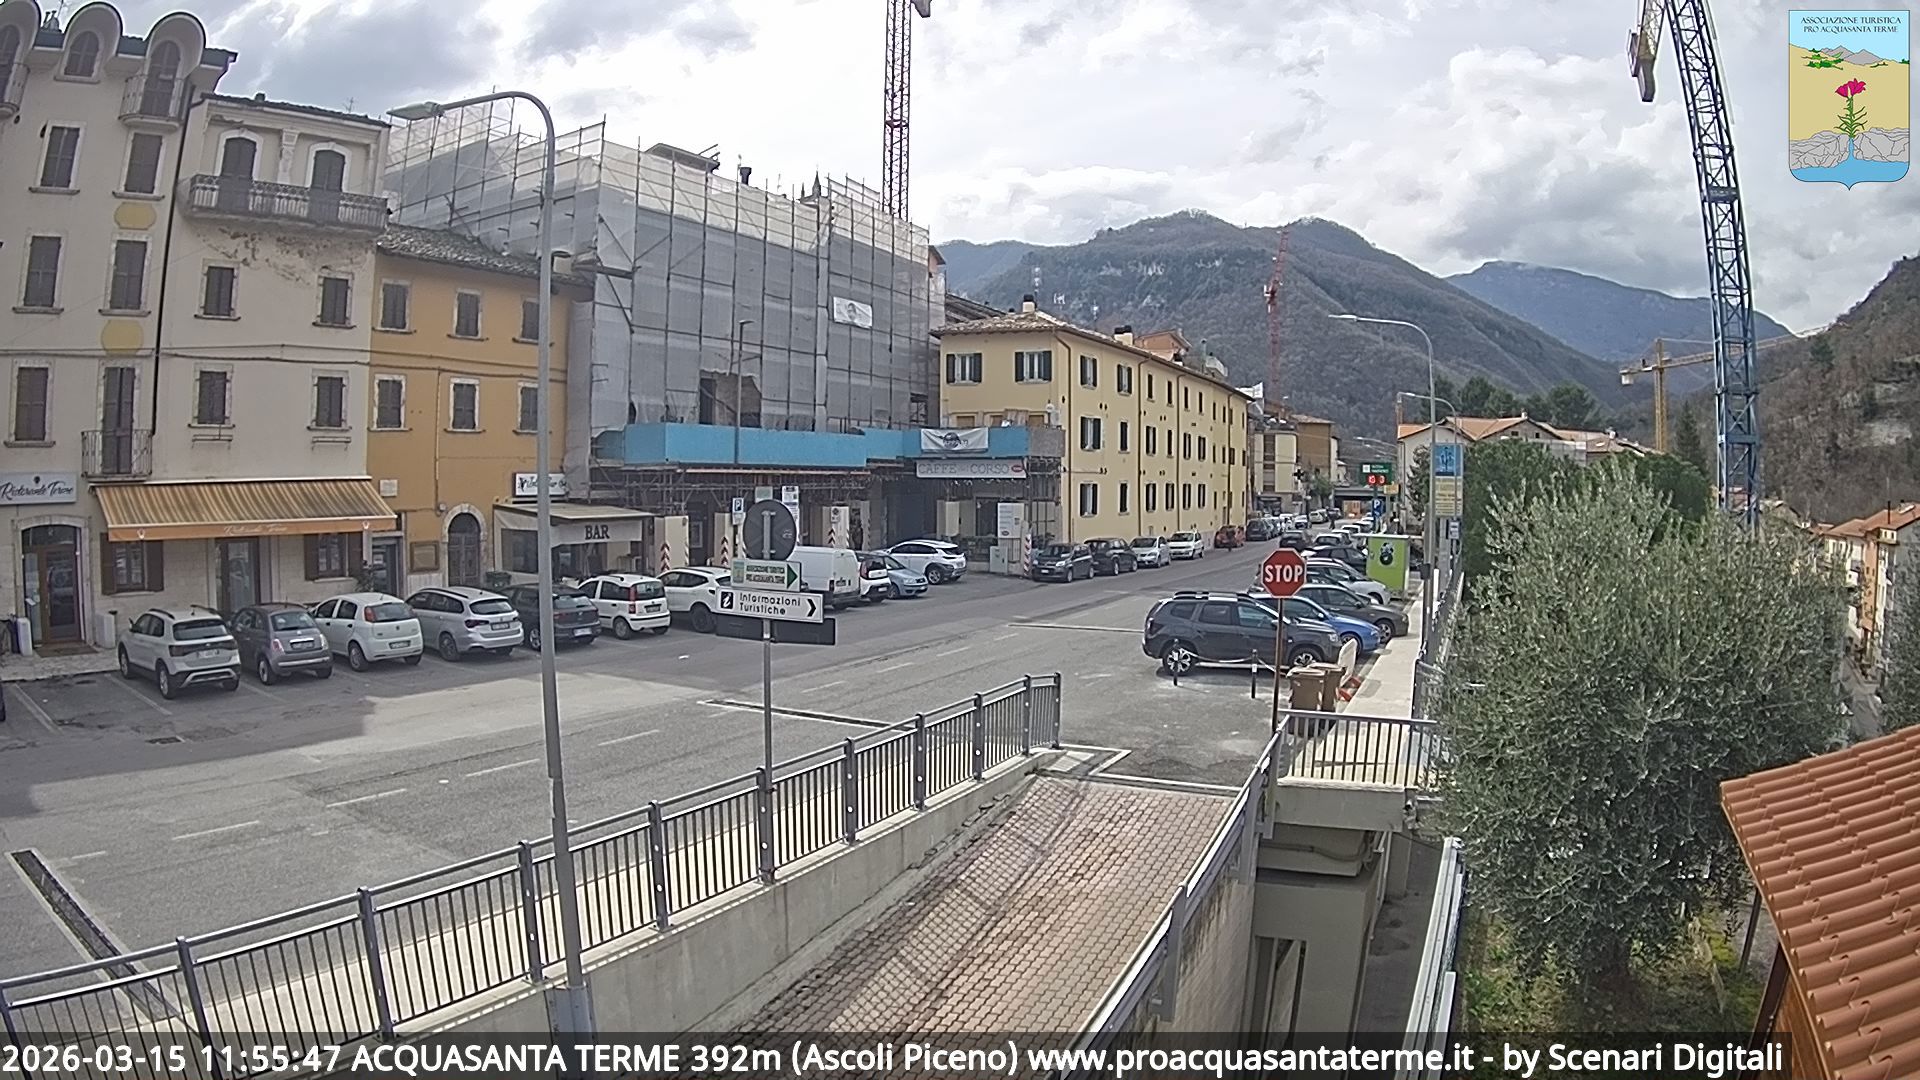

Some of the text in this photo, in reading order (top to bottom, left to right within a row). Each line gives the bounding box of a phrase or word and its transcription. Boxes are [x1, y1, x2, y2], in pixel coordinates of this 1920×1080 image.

[970, 463, 1010, 475] CORSO
[584, 525, 610, 541] BAR
[1263, 564, 1304, 583] STOP
[739, 592, 801, 607] Informazioni
[739, 602, 786, 616] Turistiche
